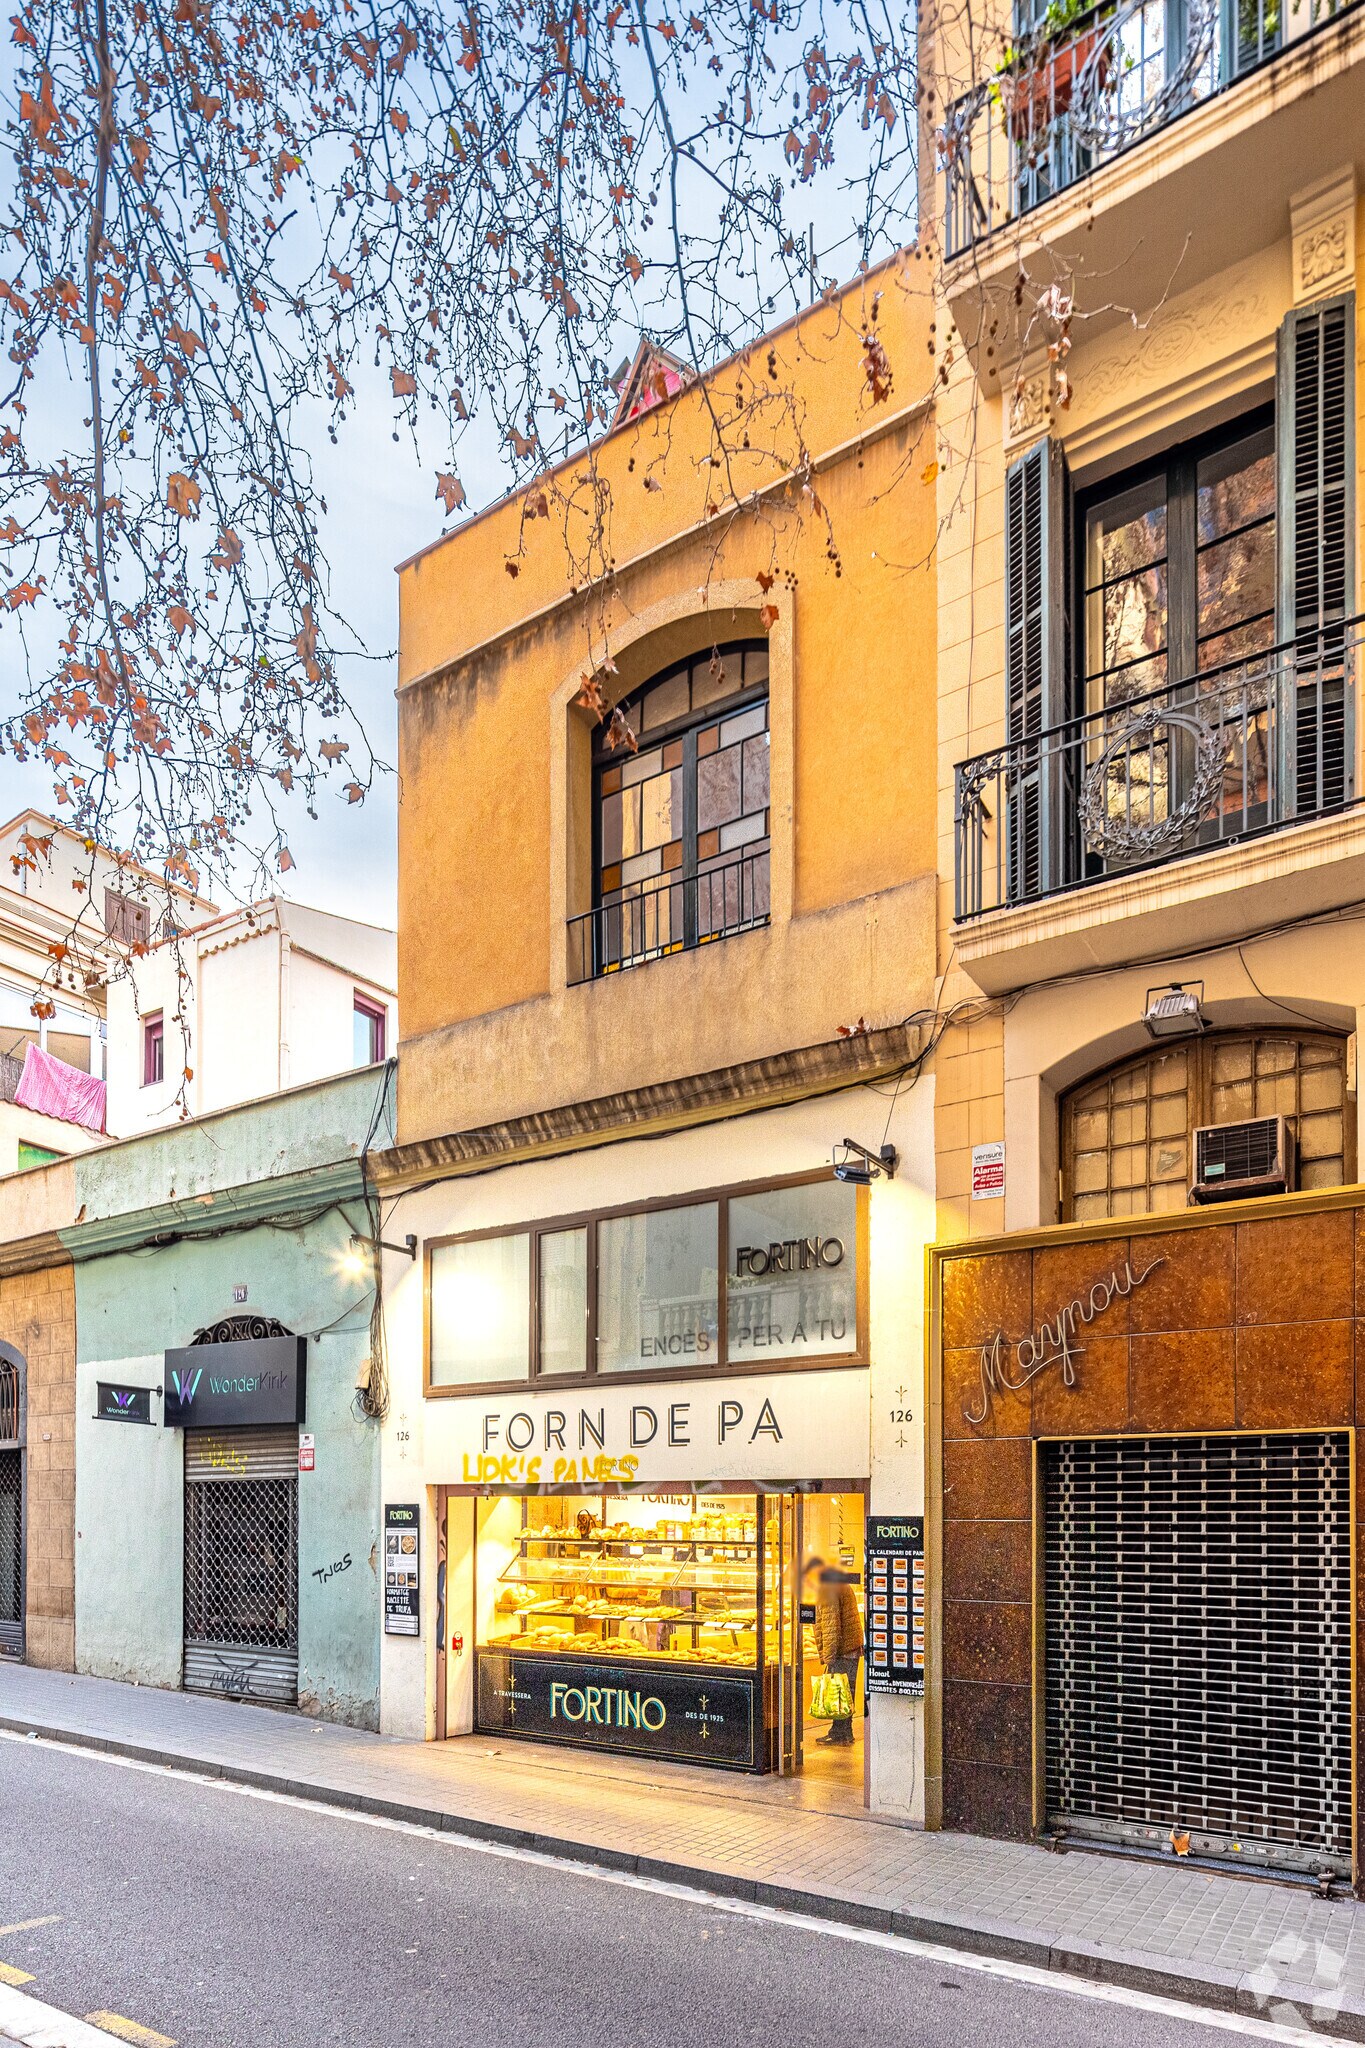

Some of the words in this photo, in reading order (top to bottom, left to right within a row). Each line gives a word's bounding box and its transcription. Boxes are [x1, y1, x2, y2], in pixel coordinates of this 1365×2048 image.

[974, 1152, 1003, 1160] verisure
[974, 1165, 1003, 1175] Alarma
[736, 1236, 845, 1278] FORTINO
[738, 1323, 784, 1348] PER
[791, 1321, 808, 1344] A
[814, 1316, 846, 1341] TU
[964, 1257, 1165, 1423] Maynou
[209, 1370, 288, 1394] WonderKink
[889, 1409, 913, 1423] 126
[483, 1406, 605, 1453] FORN
[629, 1403, 691, 1449] DE
[717, 1397, 784, 1446] PA
[397, 1431, 410, 1441] 126
[600, 1457, 639, 1472] FORTINO
[389, 1510, 414, 1521] FORTINO
[876, 1525, 919, 1538] FORTINO
[498, 1690, 532, 1700] TRAVESSERA
[549, 1682, 667, 1732] FORTINO
[685, 1711, 698, 1720] DES
[699, 1712, 708, 1721] DE
[709, 1713, 724, 1723] 1925
